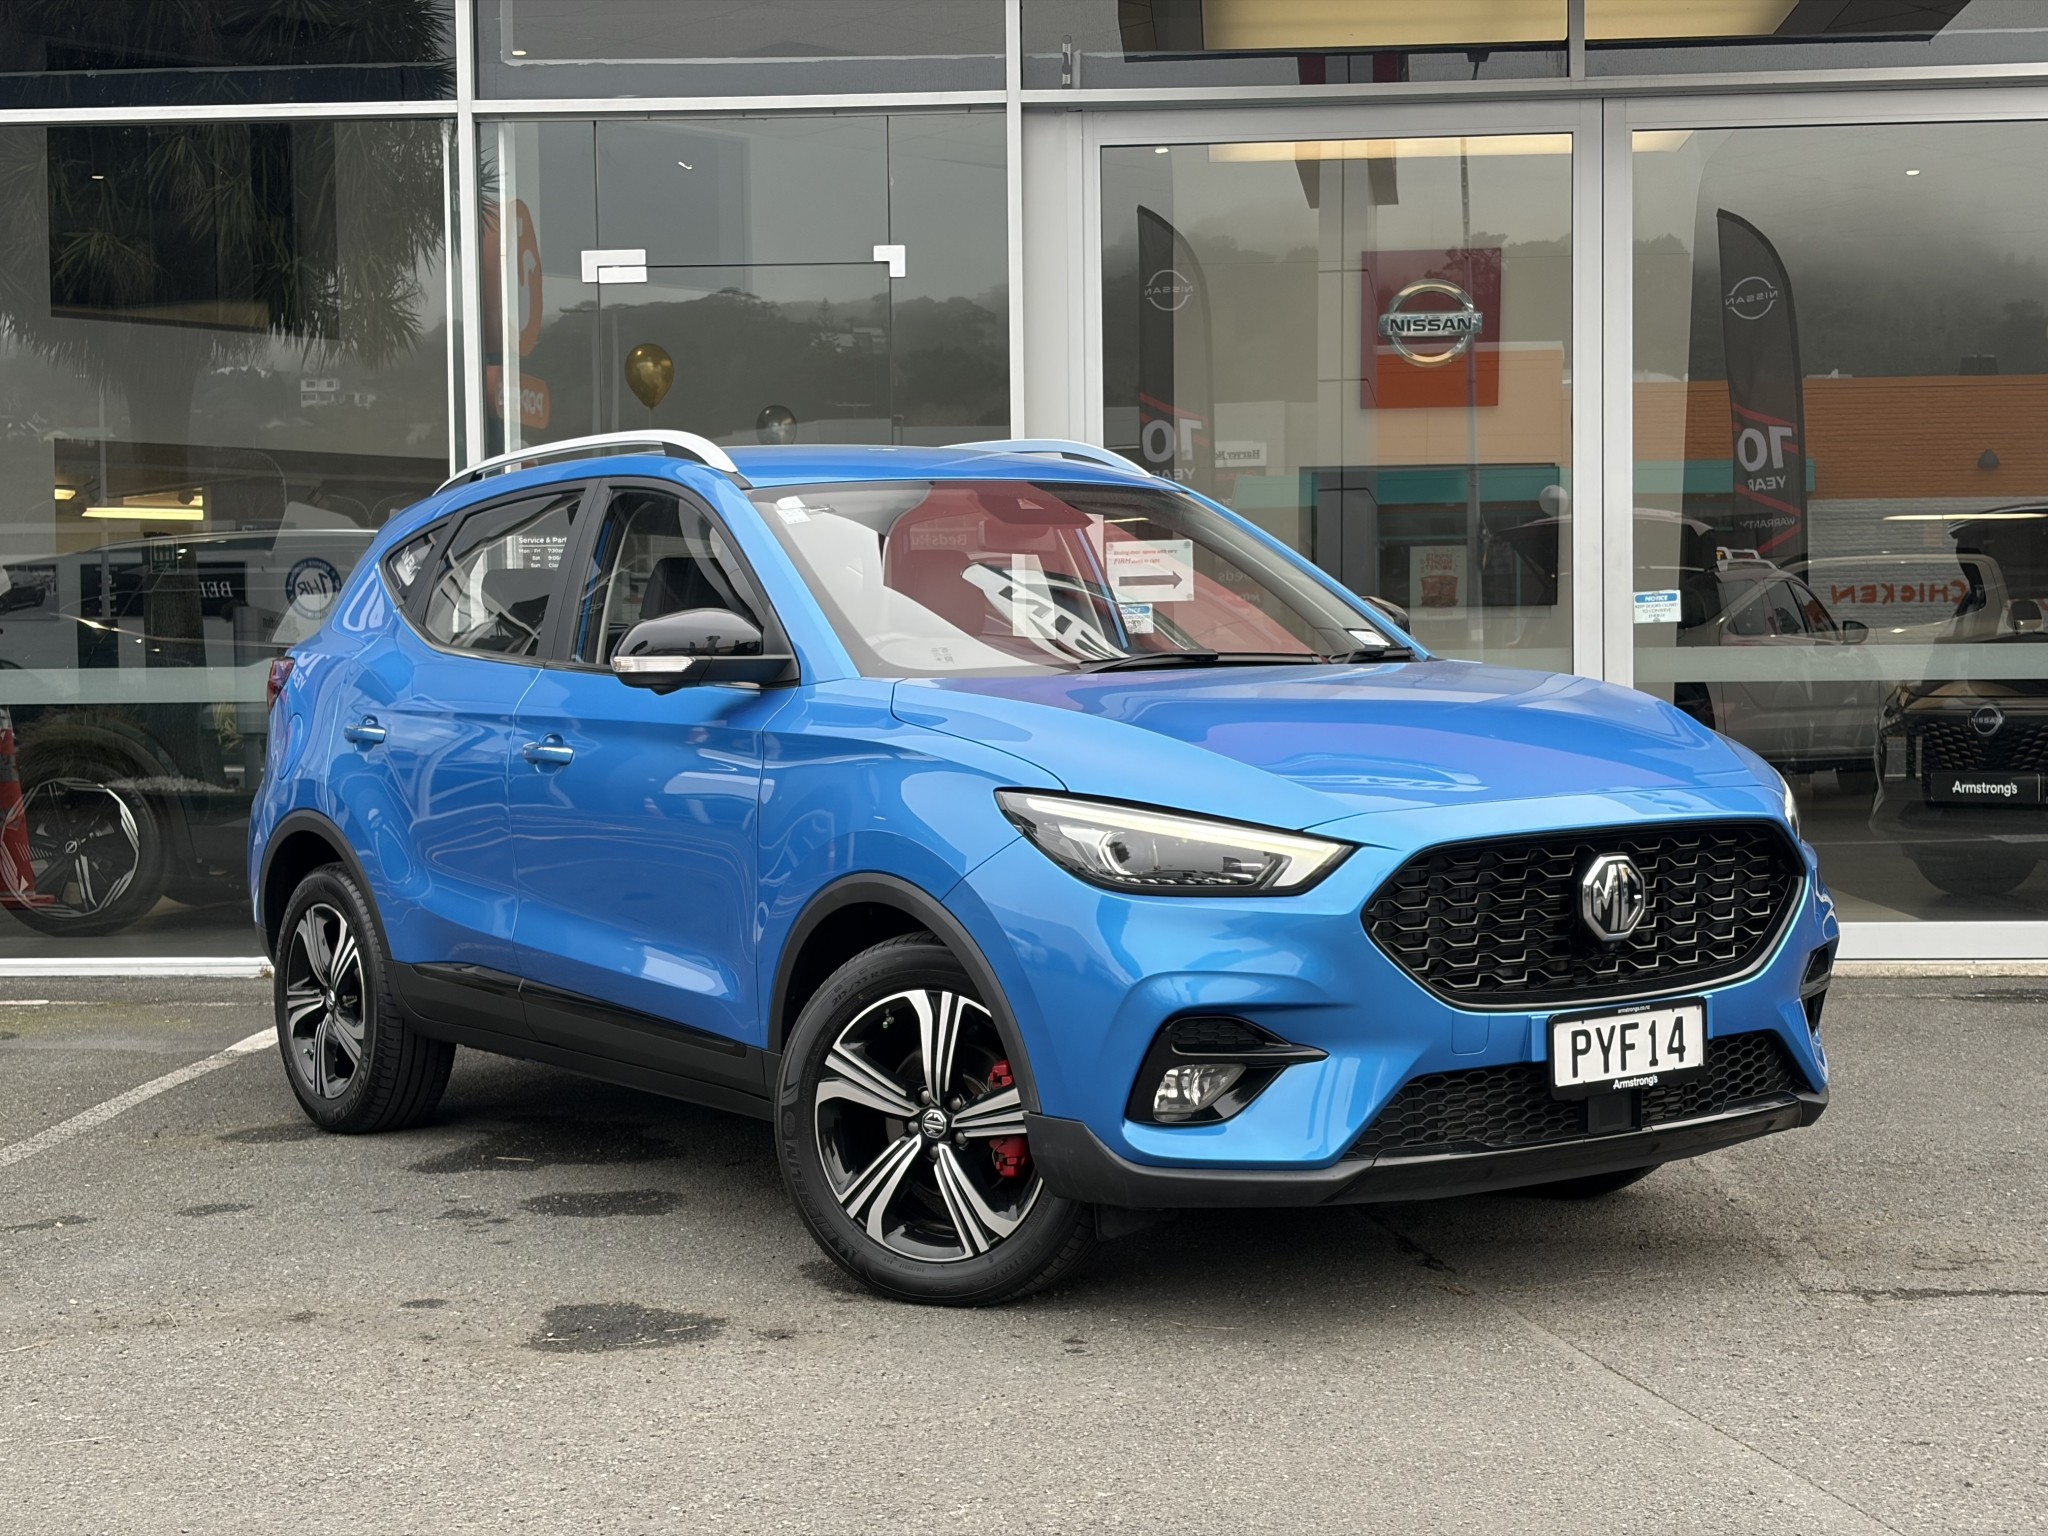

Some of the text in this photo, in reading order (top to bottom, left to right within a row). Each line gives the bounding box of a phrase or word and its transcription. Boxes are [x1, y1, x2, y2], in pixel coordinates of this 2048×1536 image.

[1389, 317, 1472, 332] NISSAN
[1952, 781, 2018, 797] Armstrong's
[1593, 864, 1641, 932] MG
[1571, 1016, 1686, 1078] PYF14
[1613, 1074, 1658, 1090] Armstrong's
